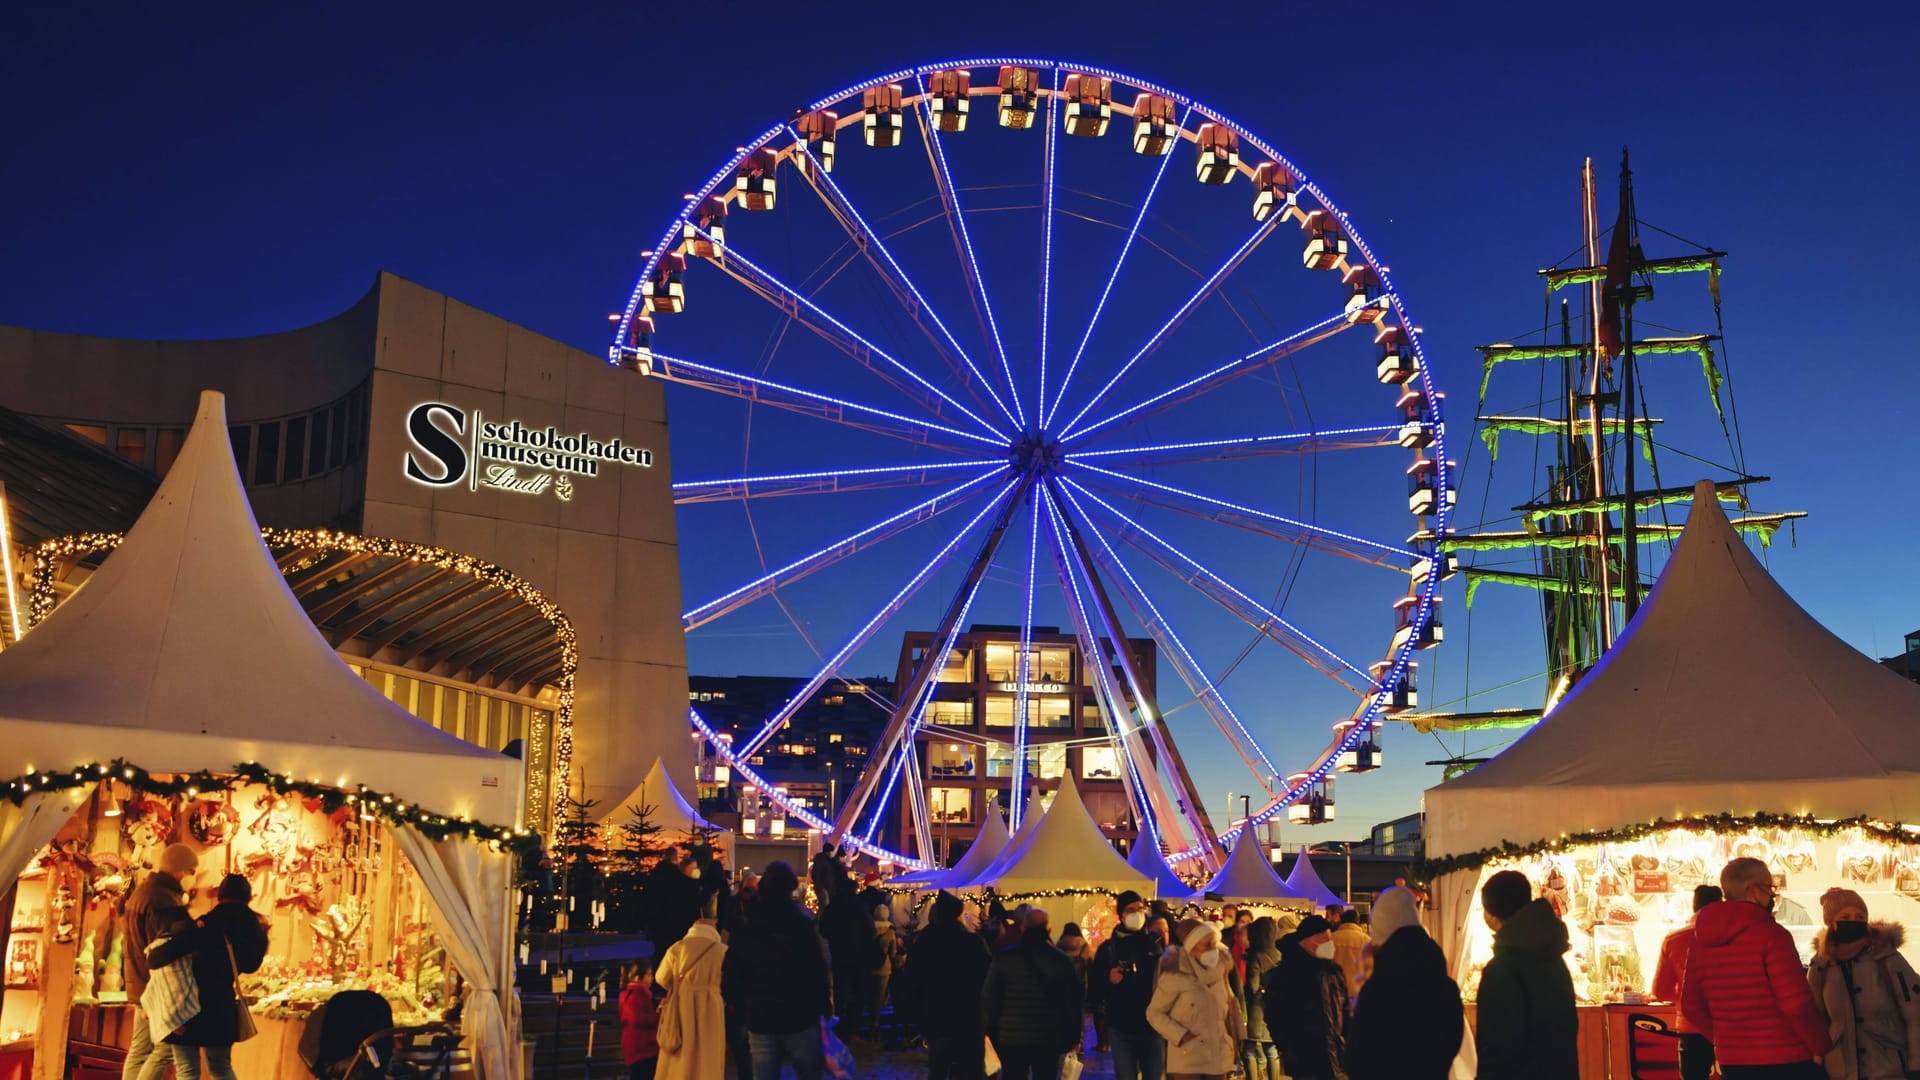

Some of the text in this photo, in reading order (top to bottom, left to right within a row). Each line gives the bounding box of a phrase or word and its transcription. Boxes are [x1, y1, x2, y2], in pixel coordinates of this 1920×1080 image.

[406, 402, 467, 485] S
[482, 441, 597, 475] museum
[483, 421, 652, 466] schokoladen
[479, 465, 551, 494] Lindt
